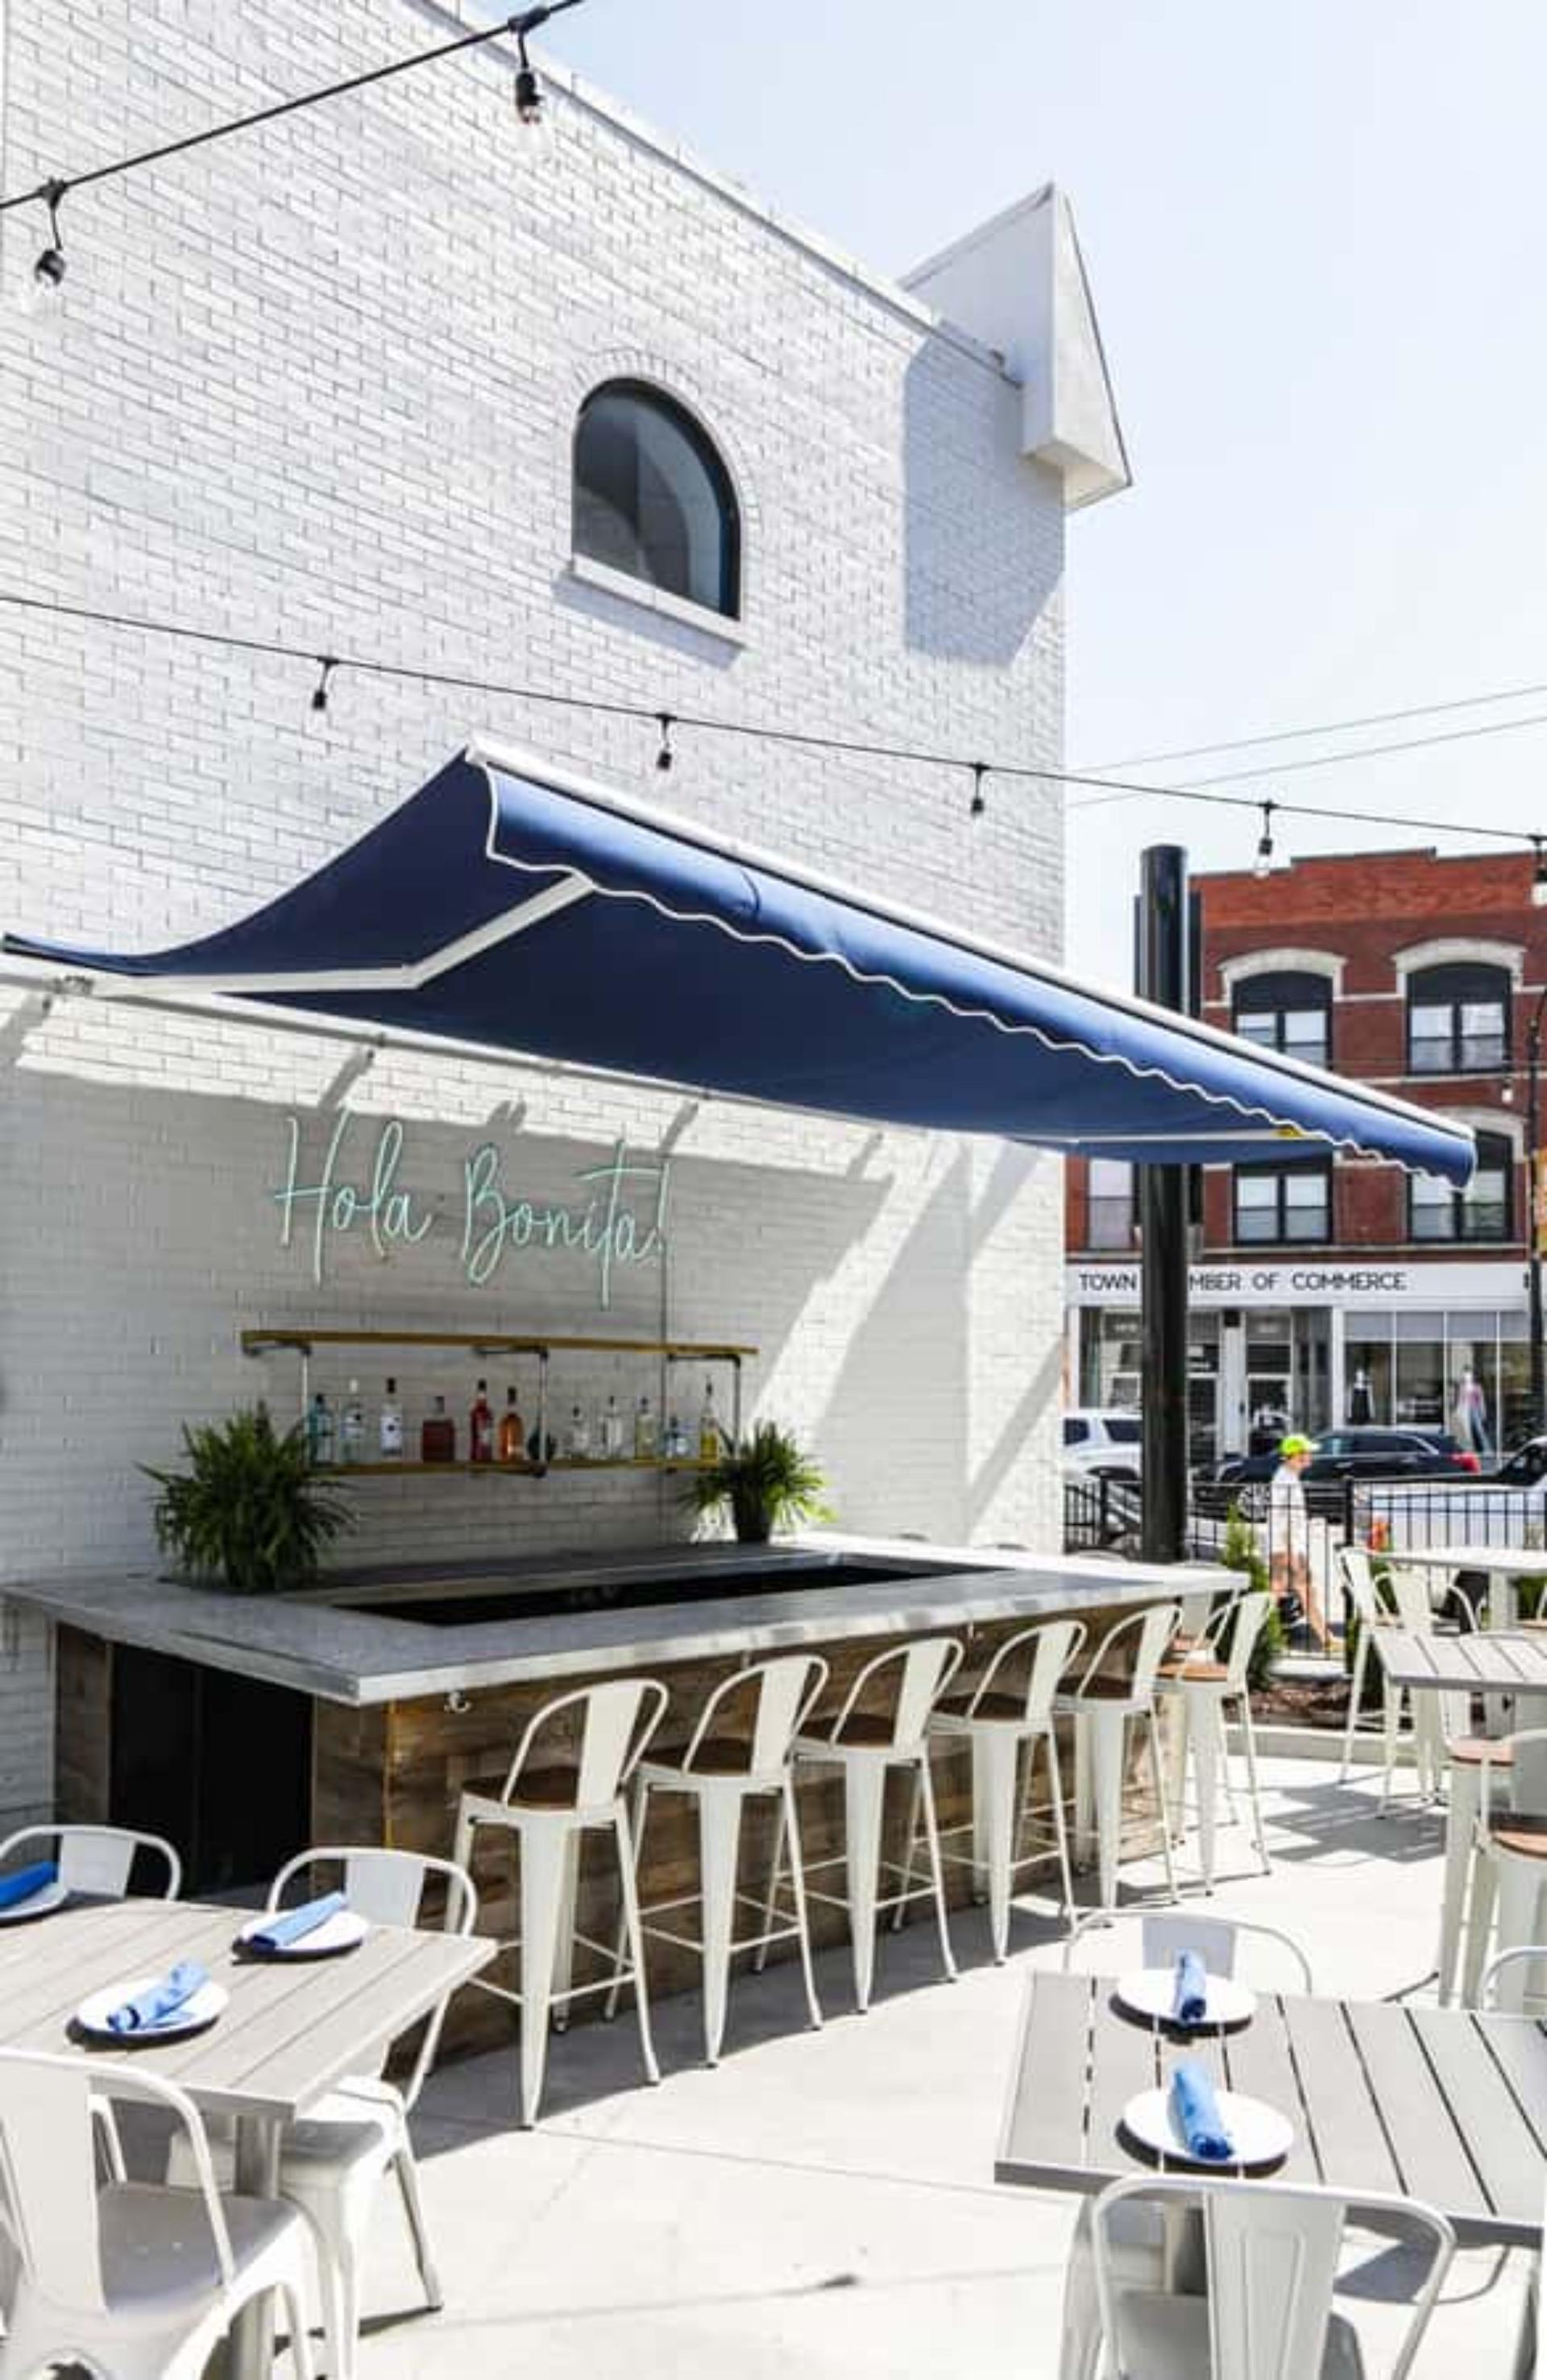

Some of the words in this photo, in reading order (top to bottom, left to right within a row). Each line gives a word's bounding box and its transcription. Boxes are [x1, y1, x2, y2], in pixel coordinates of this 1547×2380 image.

[274, 1106, 432, 1284] Hola
[461, 1136, 671, 1310] Bonita!
[1078, 1273, 1137, 1290] TOWN
[1188, 1273, 1242, 1290] MBER
[1251, 1273, 1279, 1290] OF
[1292, 1271, 1408, 1290] COMMERCE
